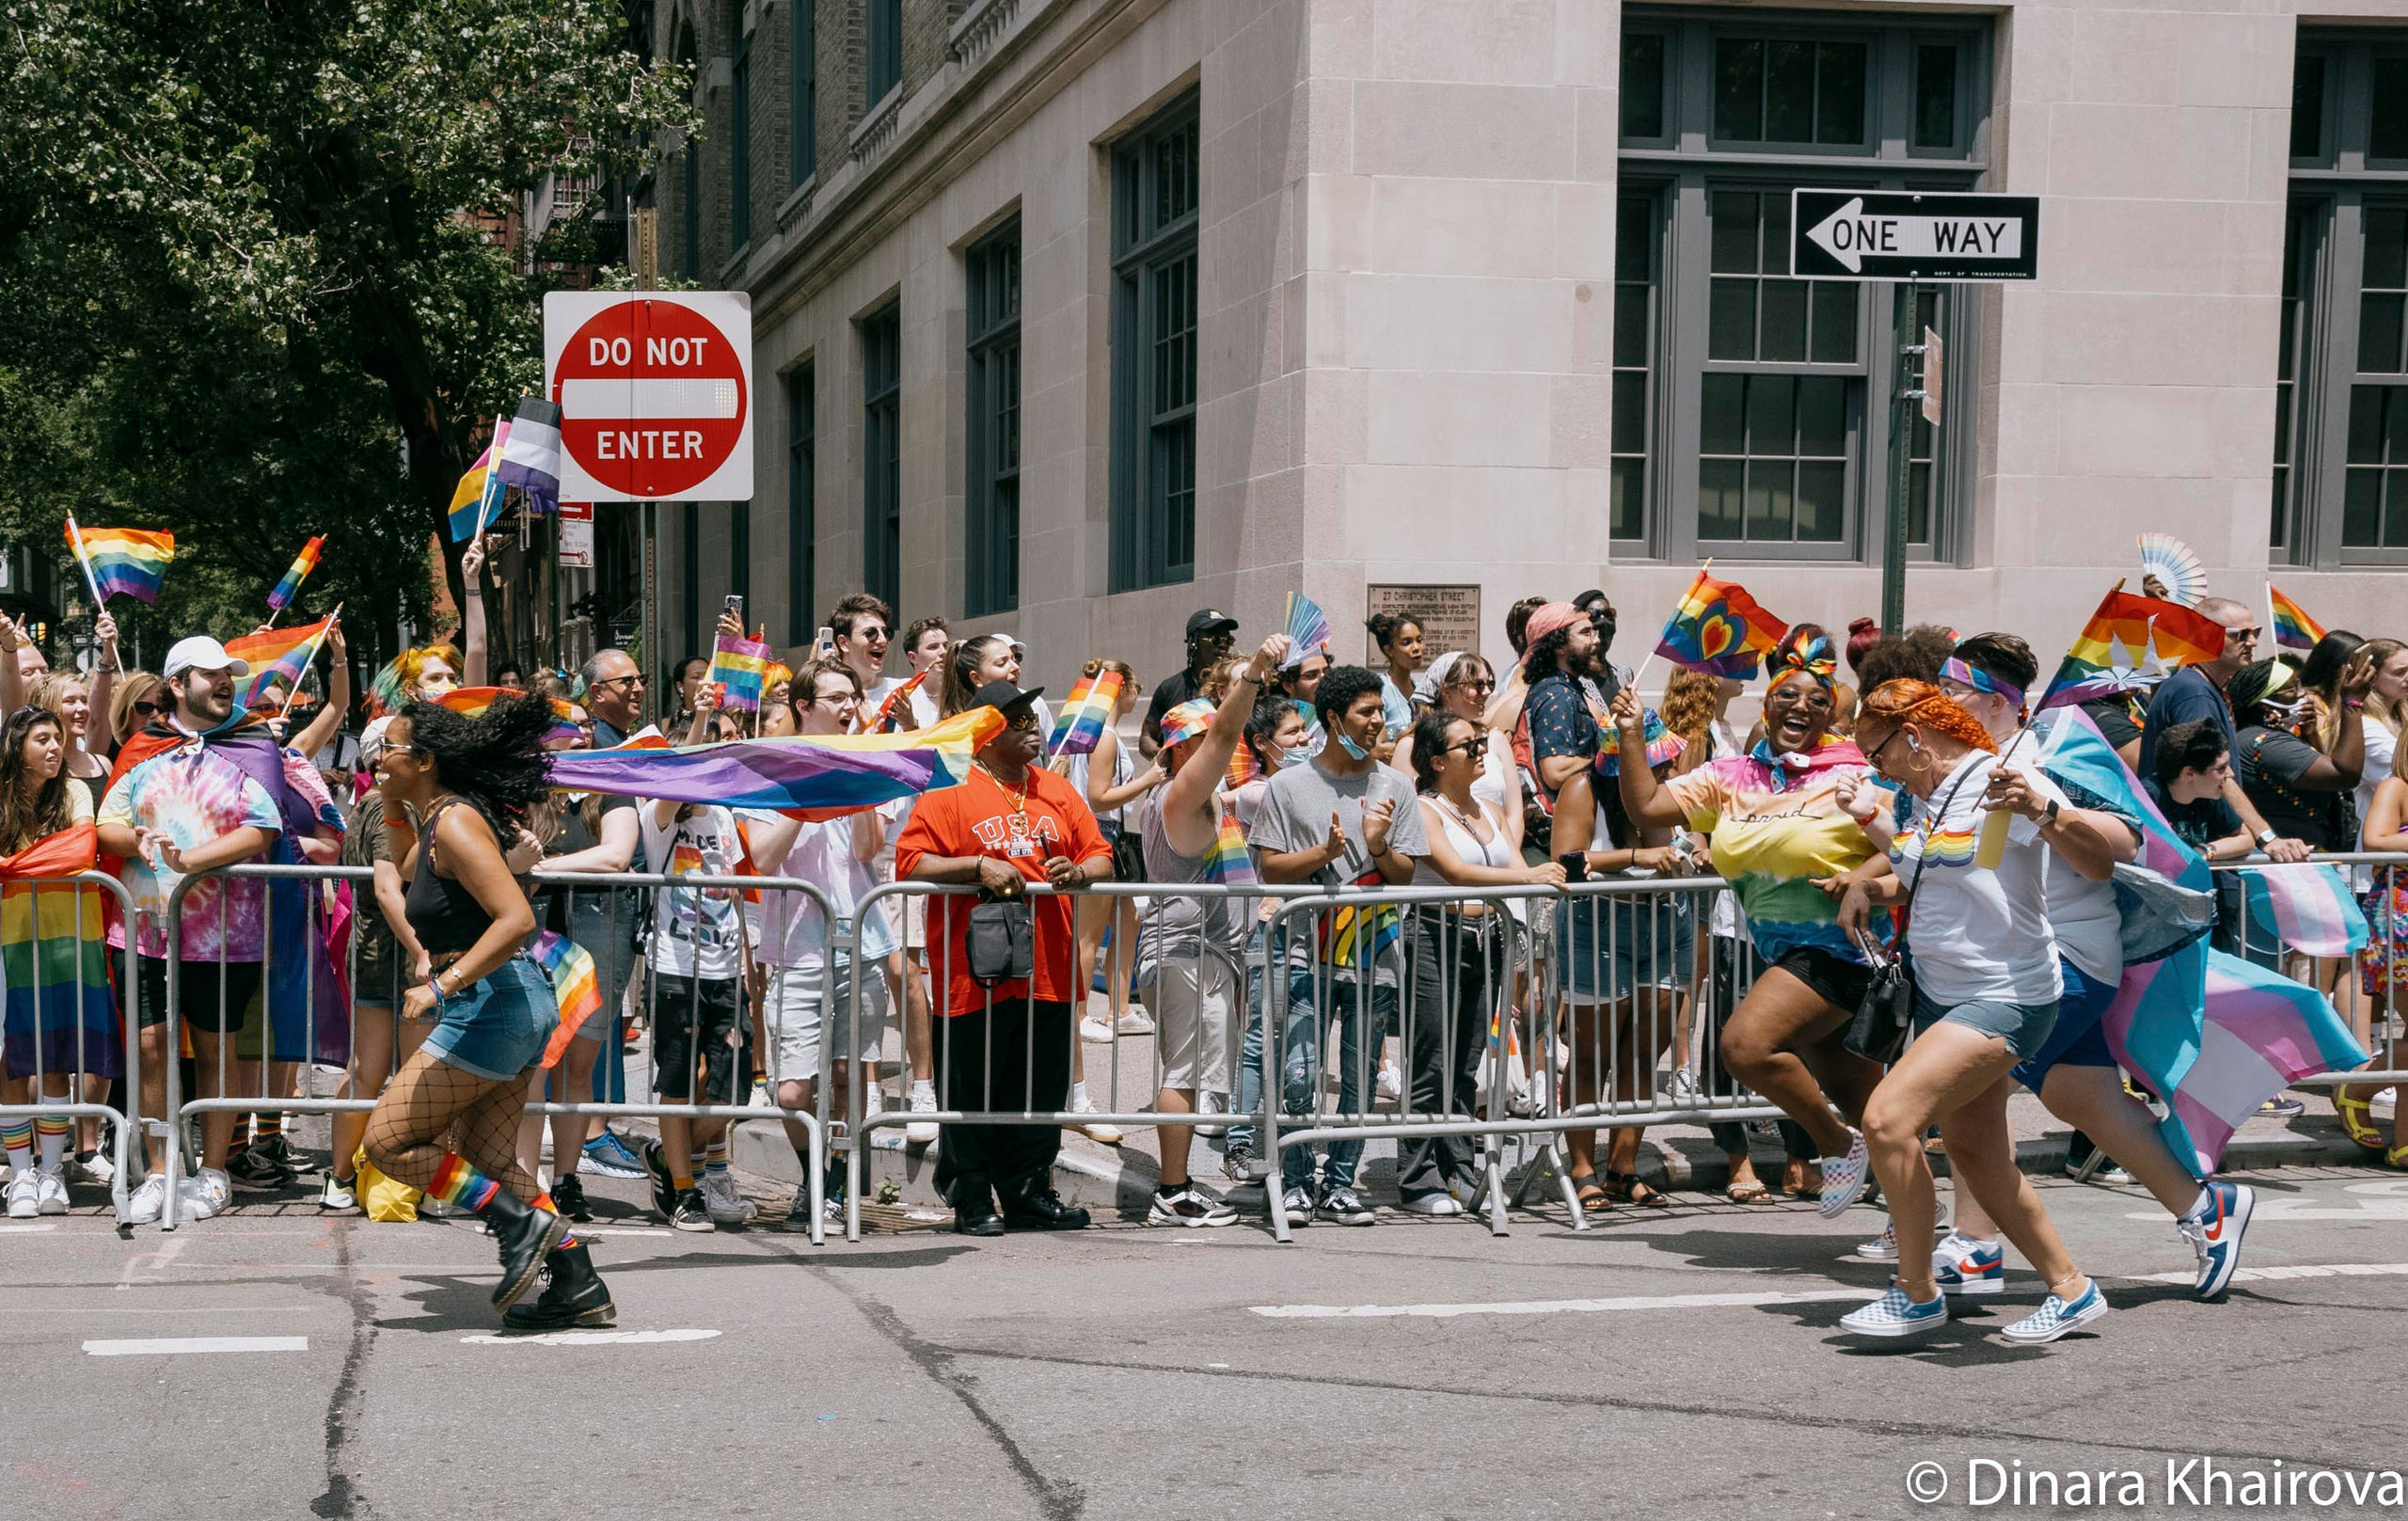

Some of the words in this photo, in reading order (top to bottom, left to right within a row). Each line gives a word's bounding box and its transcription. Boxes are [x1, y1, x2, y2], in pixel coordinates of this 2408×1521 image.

[1832, 218, 1898, 252] ONE
[1934, 221, 2007, 254] WAY
[589, 337, 632, 367] DO
[646, 337, 708, 367] NOT
[597, 431, 704, 460] ENTER
[1383, 592, 1391, 601] 27
[1394, 592, 1438, 602] CHRISTOPHER
[1441, 592, 1465, 601] STREET
[674, 828, 719, 851] MDE
[972, 814, 1060, 845] USA
